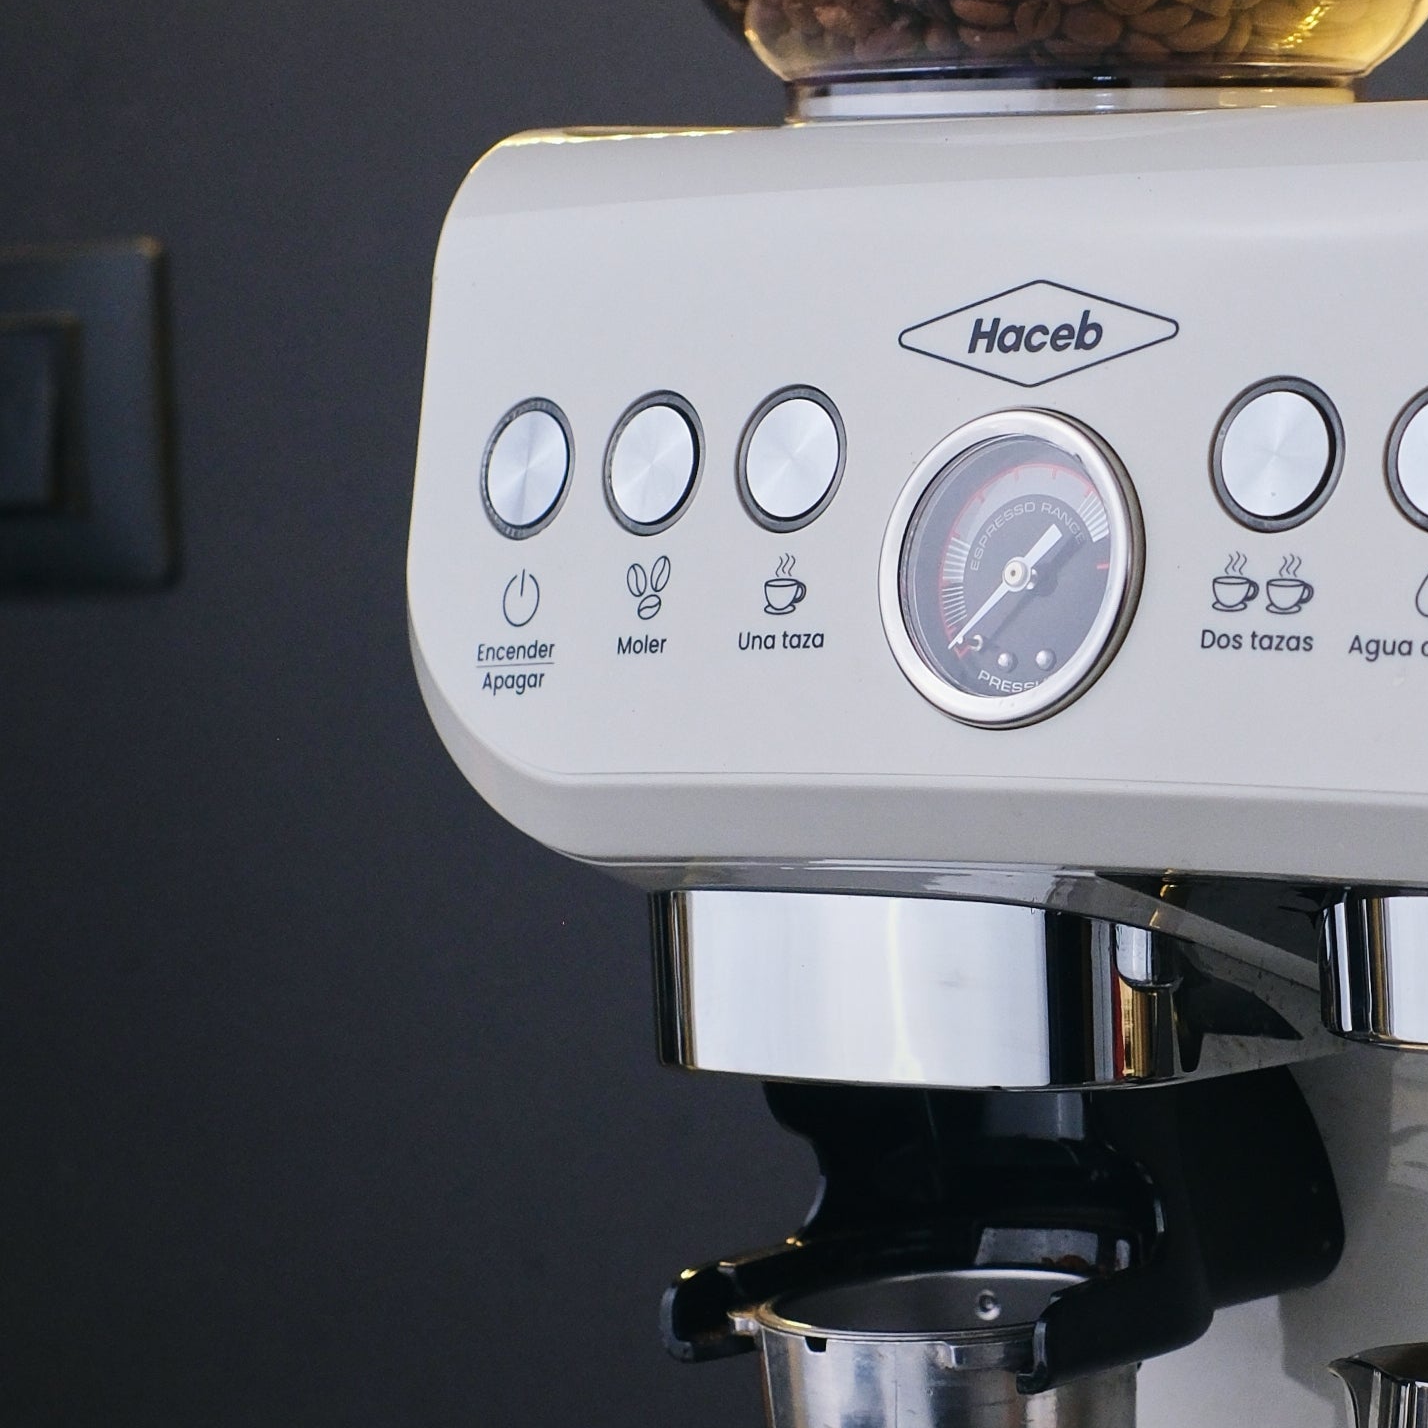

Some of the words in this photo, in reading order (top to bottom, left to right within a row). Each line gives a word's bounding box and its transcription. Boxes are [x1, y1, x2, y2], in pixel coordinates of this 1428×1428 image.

[967, 309, 1103, 355] Haceb
[970, 501, 1036, 571] ESPRESSO
[1041, 502, 1086, 545] RANGE
[477, 640, 555, 661] Encender
[617, 635, 667, 655] Moler
[738, 631, 776, 651] Una
[781, 630, 825, 650] taza
[1200, 629, 1243, 651] Dos
[1250, 630, 1314, 652] tazas
[1348, 634, 1413, 663] Agua
[482, 670, 545, 696] Apagar
[978, 670, 1039, 692] PRESS
